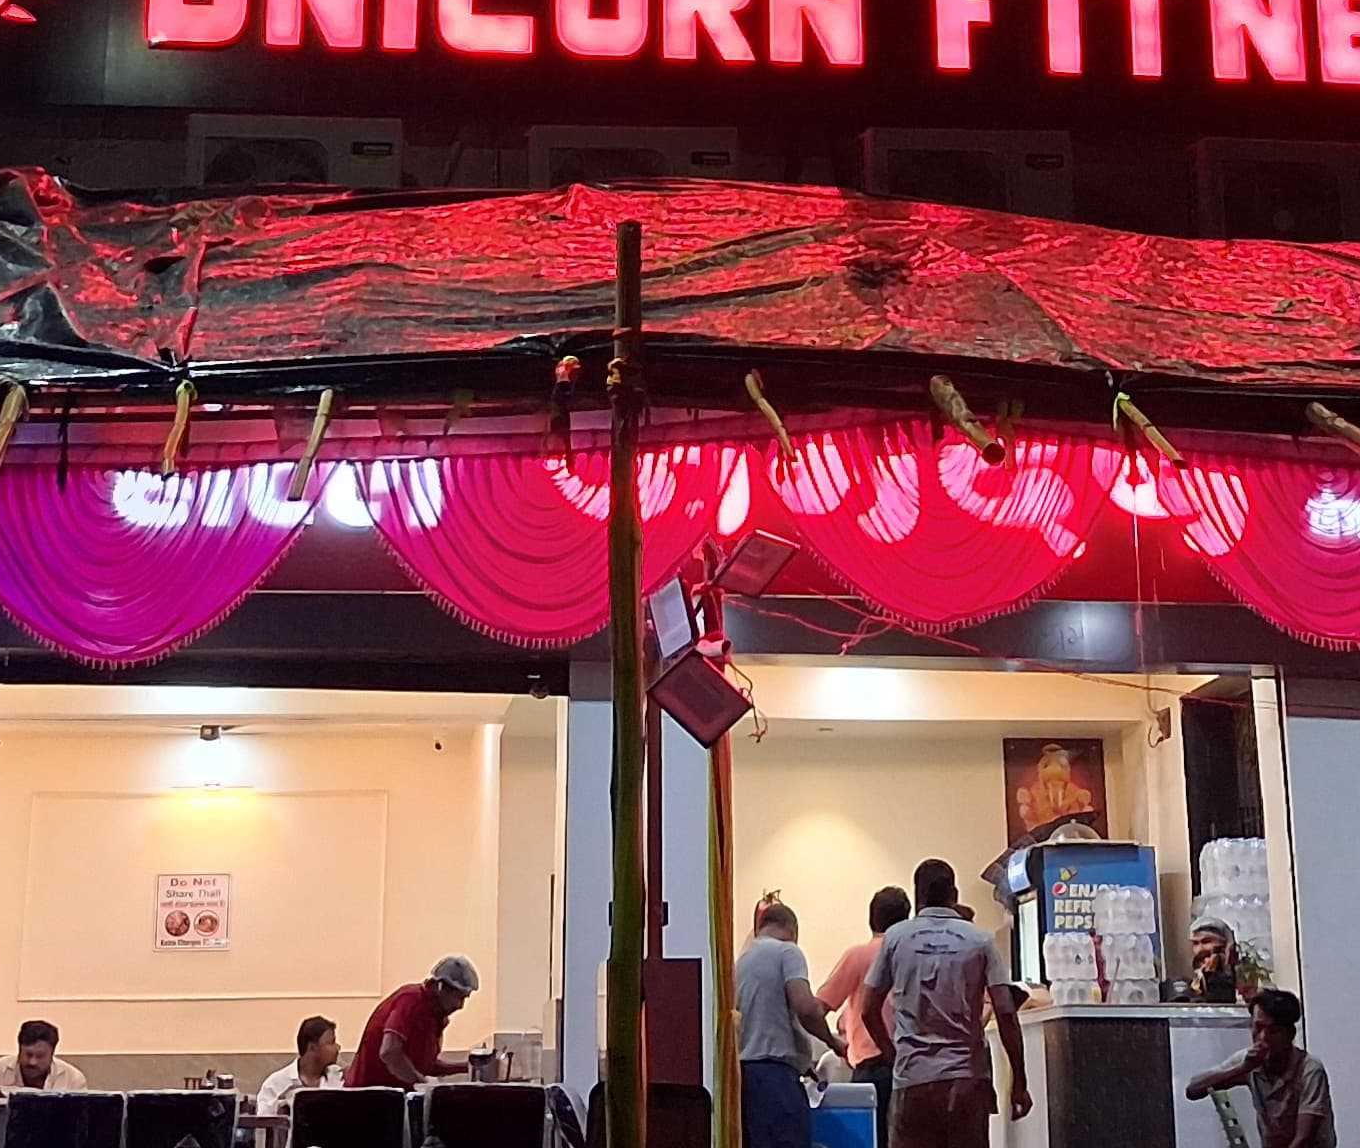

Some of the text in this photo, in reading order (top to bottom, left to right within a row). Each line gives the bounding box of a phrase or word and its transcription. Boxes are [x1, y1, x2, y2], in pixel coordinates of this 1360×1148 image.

[170, 877, 217, 887] Do Not
[1069, 883, 1120, 898] ENJ
[1054, 899, 1093, 913] REFR
[1054, 915, 1094, 929] PEPS
